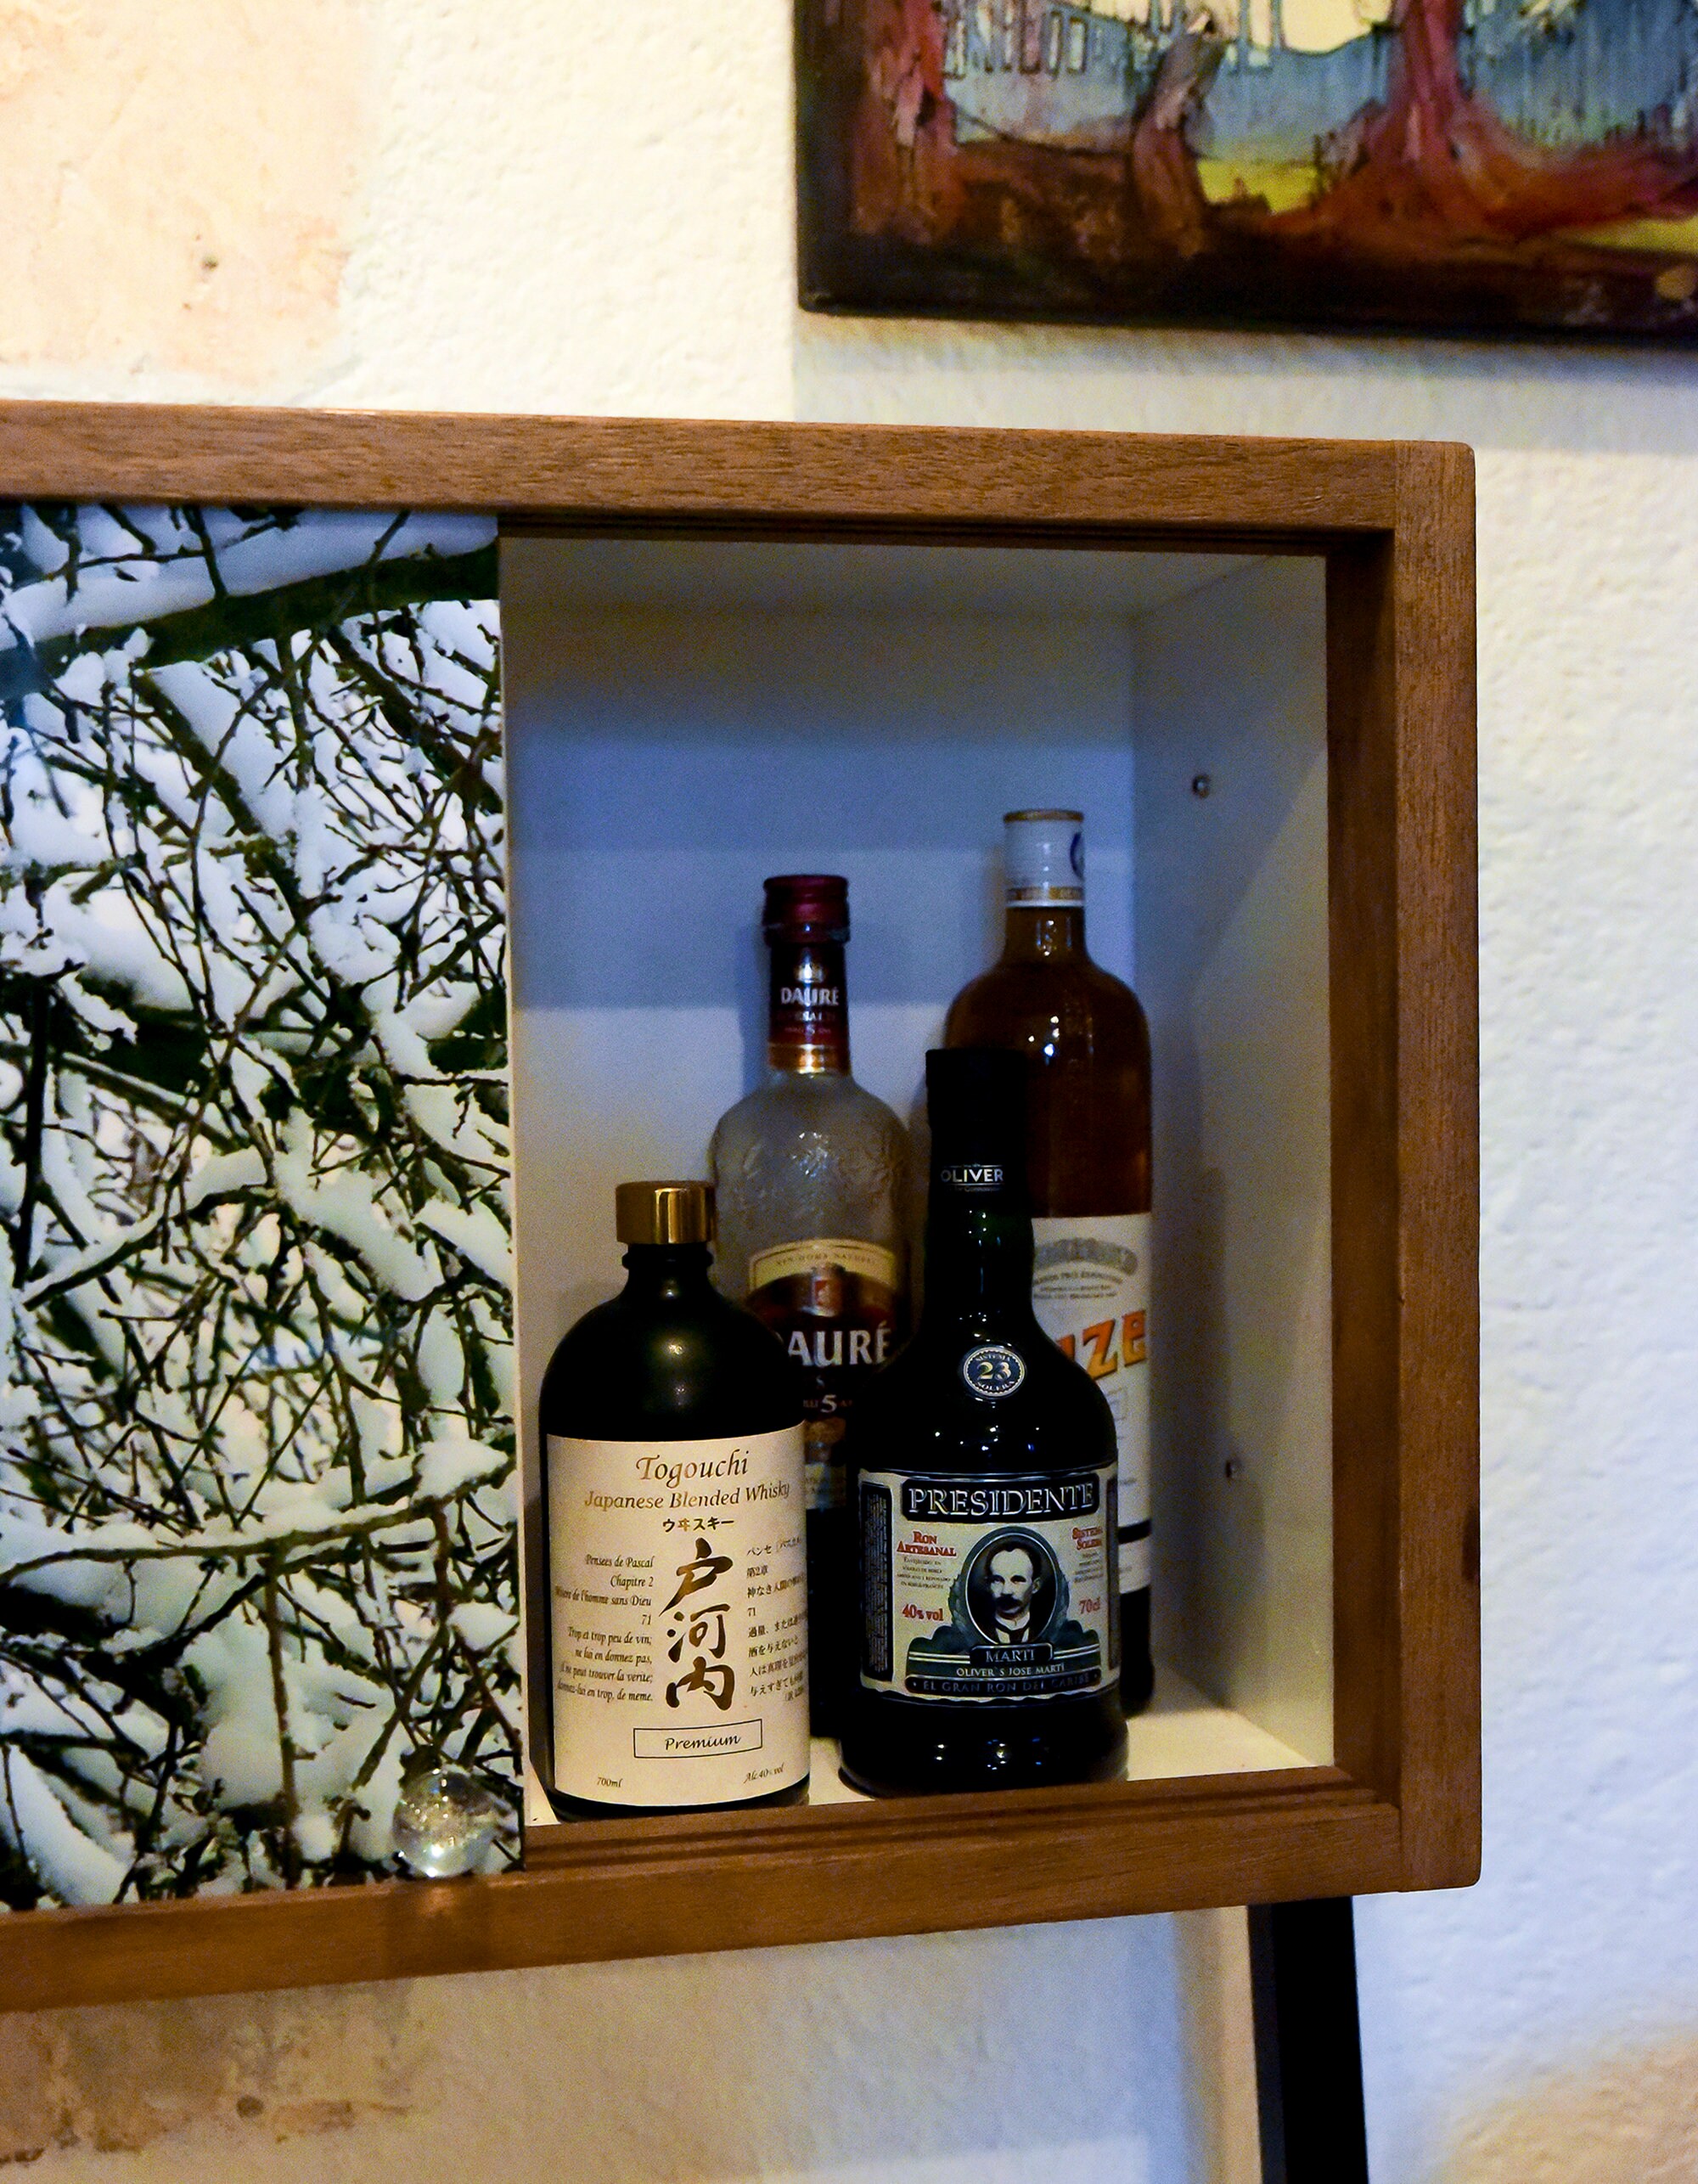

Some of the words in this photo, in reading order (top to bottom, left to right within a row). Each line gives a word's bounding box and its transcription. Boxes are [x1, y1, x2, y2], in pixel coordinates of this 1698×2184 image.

[781, 987, 839, 1006] DAURÉ
[941, 1168, 1004, 1183] OLIVER
[776, 1320, 892, 1367] AURÉ
[1055, 1309, 1146, 1381] ZE
[976, 1361, 1012, 1381] 23
[820, 1394, 838, 1413] 5
[635, 1449, 750, 1489] Togouchi
[584, 1490, 664, 1511] Japanese
[669, 1488, 740, 1509] Blended
[745, 1480, 790, 1503] Whisky
[908, 1482, 1094, 1517] PRESIDENTE
[614, 1555, 624, 1567] de
[626, 1556, 655, 1568] Pascal
[610, 1573, 645, 1590] Chapitre
[649, 1577, 654, 1587] 2
[611, 1596, 628, 1606] sans
[630, 1595, 651, 1607] Dieu
[641, 1614, 651, 1625] 71
[747, 1607, 756, 1617] 71
[925, 1608, 943, 1621] vol
[591, 1631, 606, 1646] trop
[608, 1635, 621, 1646] peu
[623, 1631, 633, 1644] de
[594, 1652, 603, 1661] en
[605, 1649, 633, 1663] donnez
[635, 1655, 652, 1667] pas,
[986, 1649, 1035, 1663] MARTI
[588, 1669, 615, 1680] trouver
[616, 1669, 624, 1681] la
[1009, 1665, 1032, 1676] JOSE
[923, 1680, 936, 1691] EL
[942, 1681, 981, 1692] GRAN
[987, 1681, 1016, 1693] RON
[1023, 1680, 1046, 1691] DEL
[1051, 1673, 1090, 1690] CARIBE
[587, 1688, 595, 1697] en
[616, 1688, 626, 1701] de
[665, 1734, 741, 1751] Premium
[597, 1776, 623, 1787] 700ml
